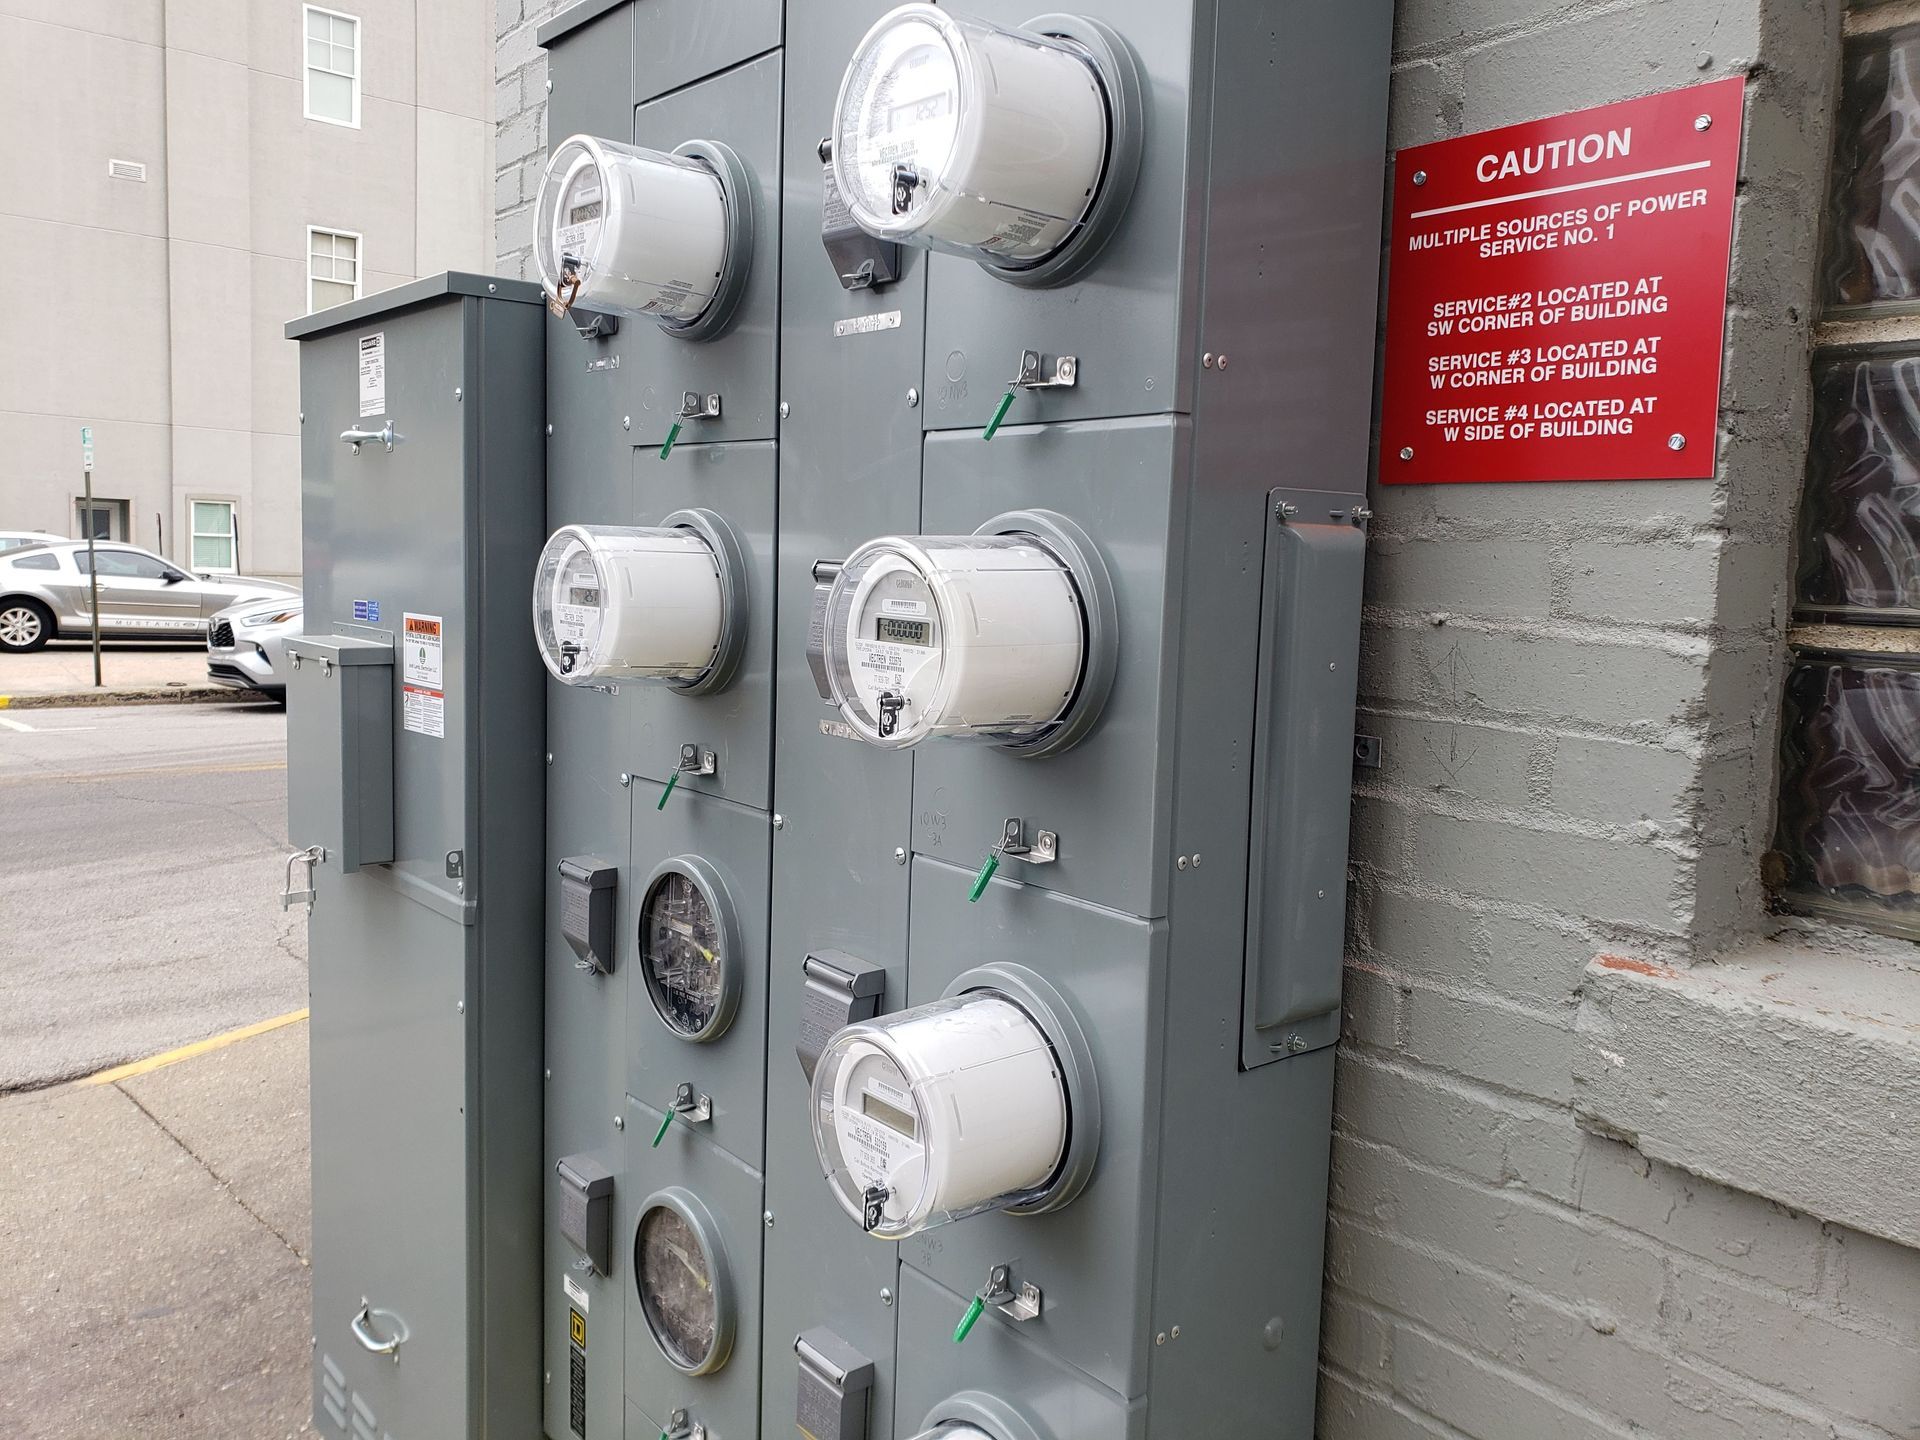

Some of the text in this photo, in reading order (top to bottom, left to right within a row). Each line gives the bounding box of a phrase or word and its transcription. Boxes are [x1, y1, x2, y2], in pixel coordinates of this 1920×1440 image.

[1477, 127, 1631, 182] CAUTION
[1409, 189, 1707, 251] MULTIPLE SOURCES OF POWER
[1480, 224, 1614, 258] SERVICE NO. 1
[1538, 281, 1629, 306] LOCATED
[1634, 276, 1662, 295] AT
[1428, 296, 1667, 336] SW CORNER OF BUILDING
[1429, 337, 1661, 372] SERVICE #3 LOCATED AT
[1431, 357, 1656, 389] W CORNER OF BUILDING
[1426, 397, 1657, 425] SERVICE #4 LOCATED AT
[1444, 418, 1632, 441] W SIDE OF BUILDING
[414, 620, 436, 635] WARNING
